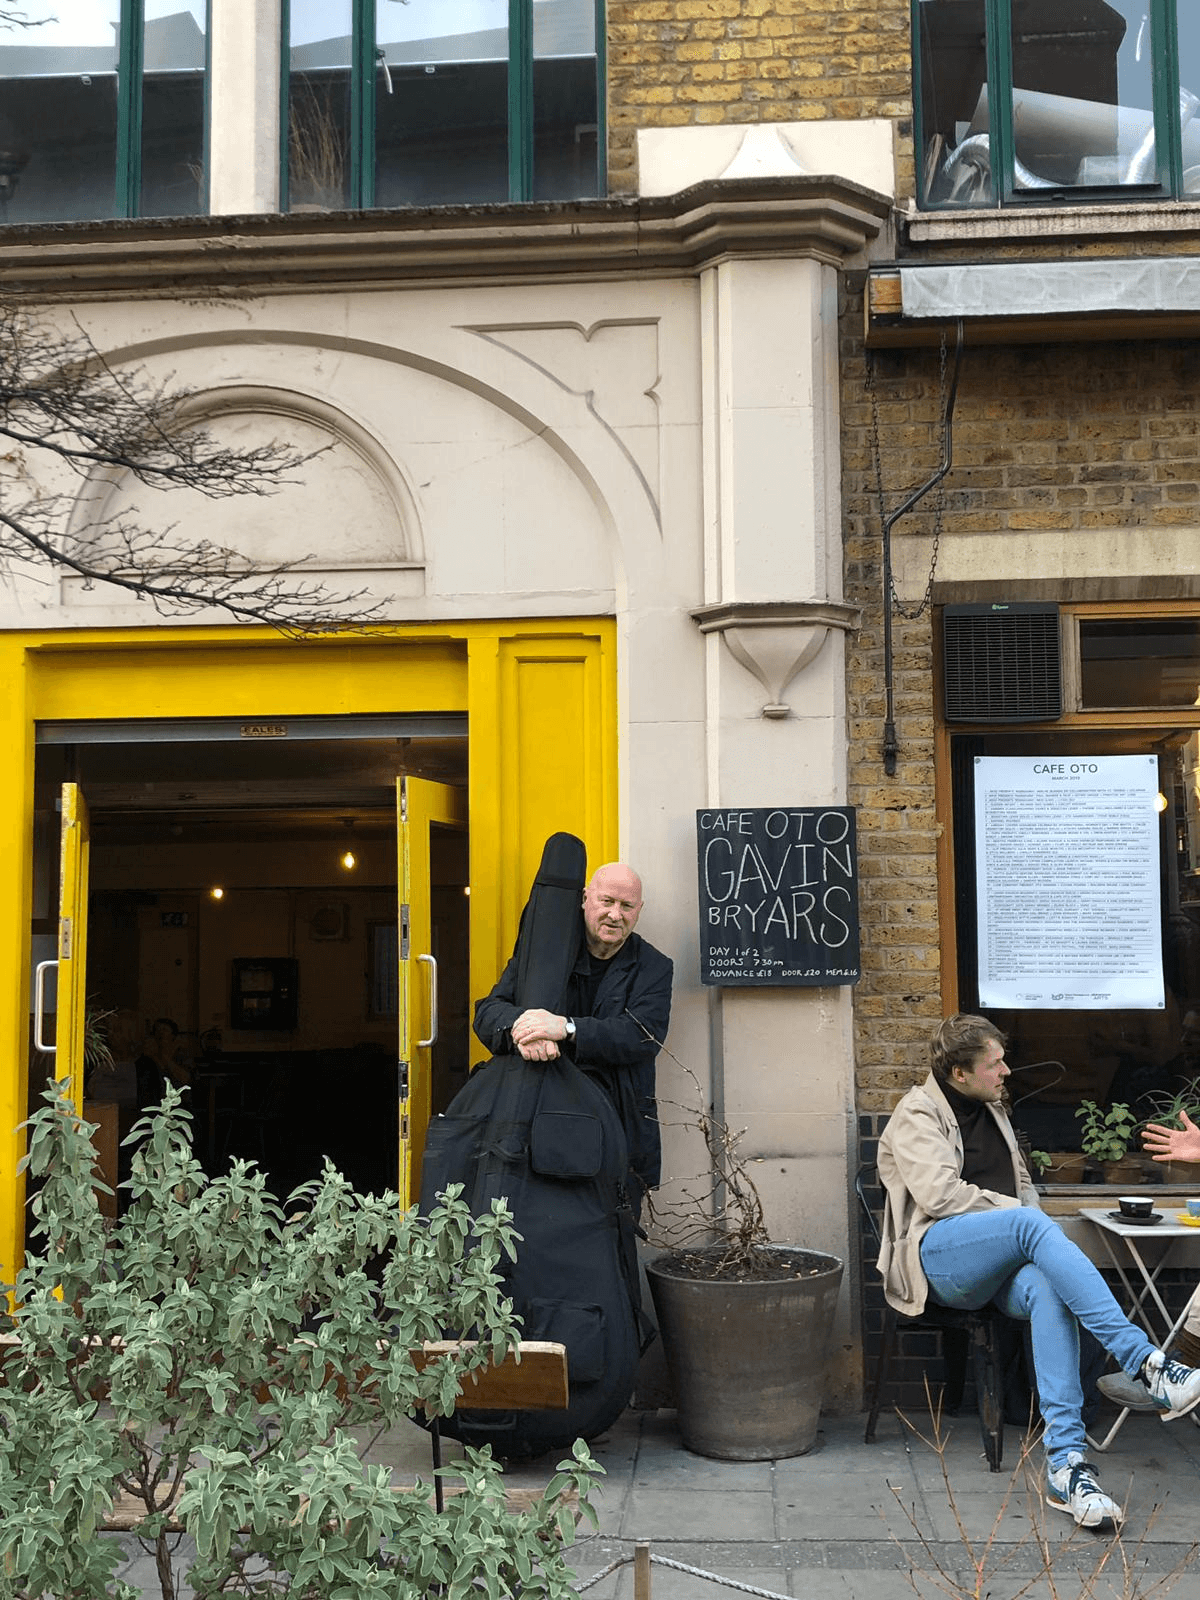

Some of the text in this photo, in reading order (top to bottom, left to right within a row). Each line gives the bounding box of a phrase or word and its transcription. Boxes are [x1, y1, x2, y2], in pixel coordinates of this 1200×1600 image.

[1033, 764, 1098, 774] CAFE OTO
[700, 811, 849, 844] CAFE OTO
[705, 837, 853, 902] GAVIN
[708, 886, 851, 948] BRYARS
[709, 946, 760, 957] DAY 1 of 2
[709, 958, 744, 967] DOORS
[709, 969, 755, 978] ADVANCE
[781, 969, 803, 977] DOOR
